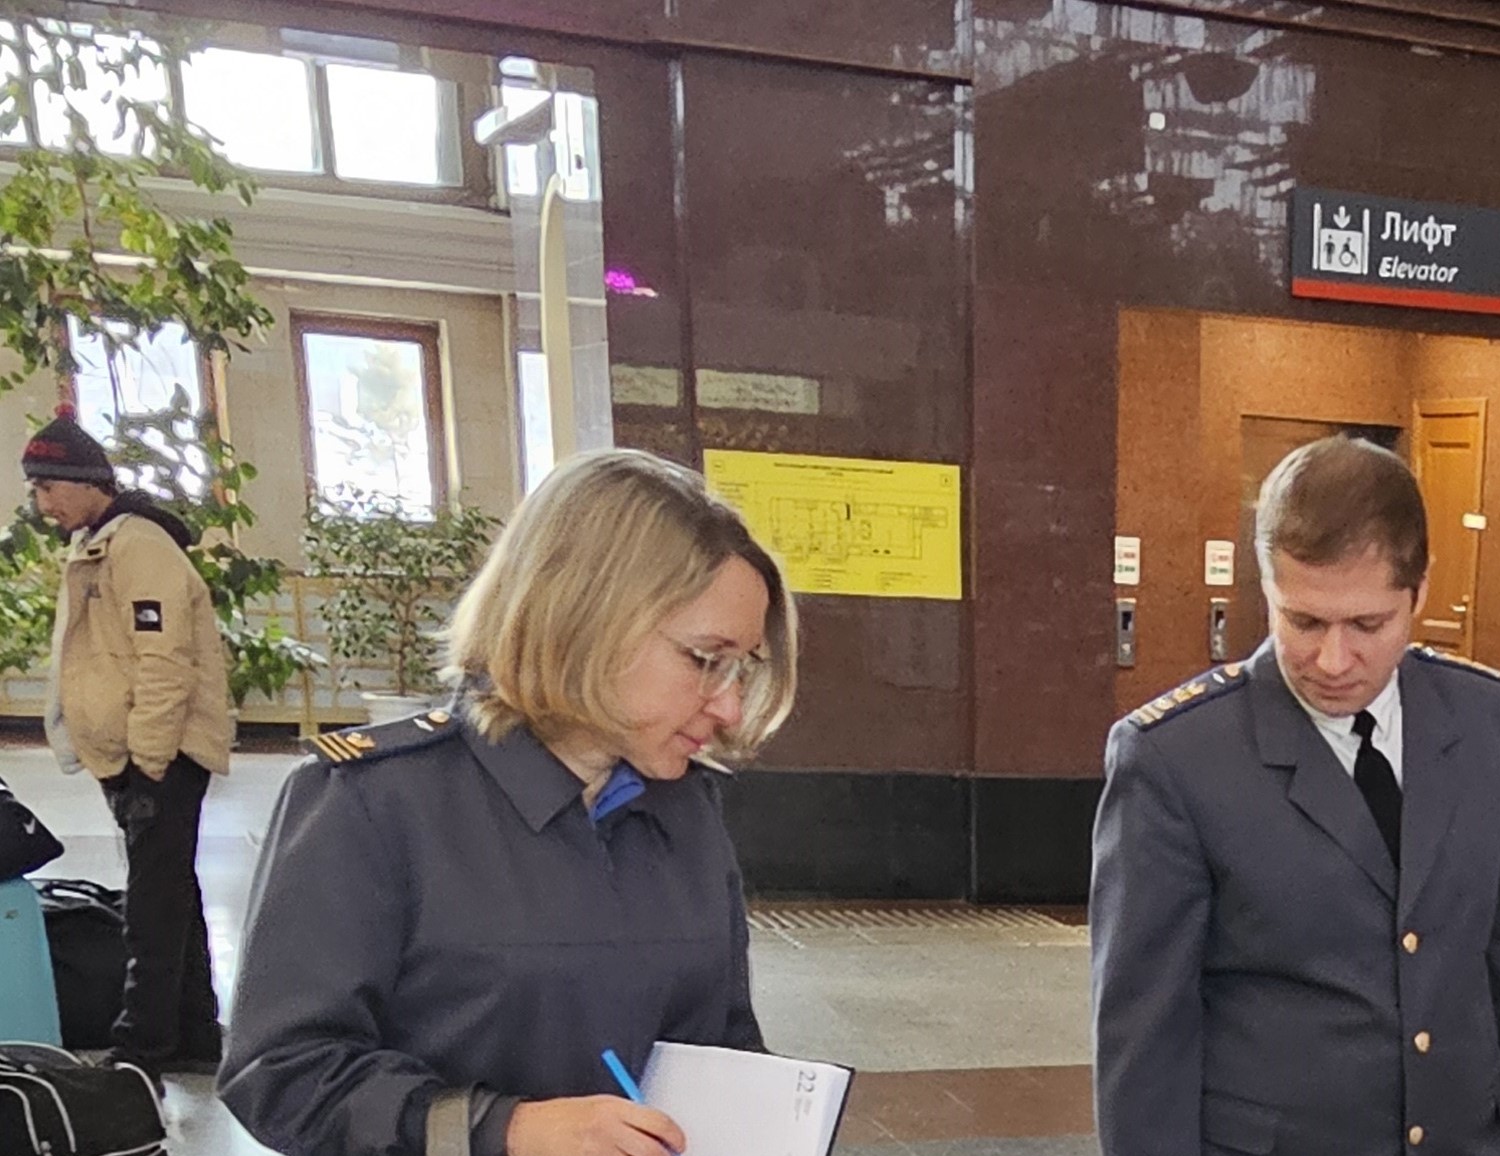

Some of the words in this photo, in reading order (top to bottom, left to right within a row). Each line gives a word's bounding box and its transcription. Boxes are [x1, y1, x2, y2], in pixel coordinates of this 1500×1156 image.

[1380, 211, 1457, 254] Лифт
[1378, 255, 1459, 283] Elevator
[797, 1069, 816, 1093] 22
